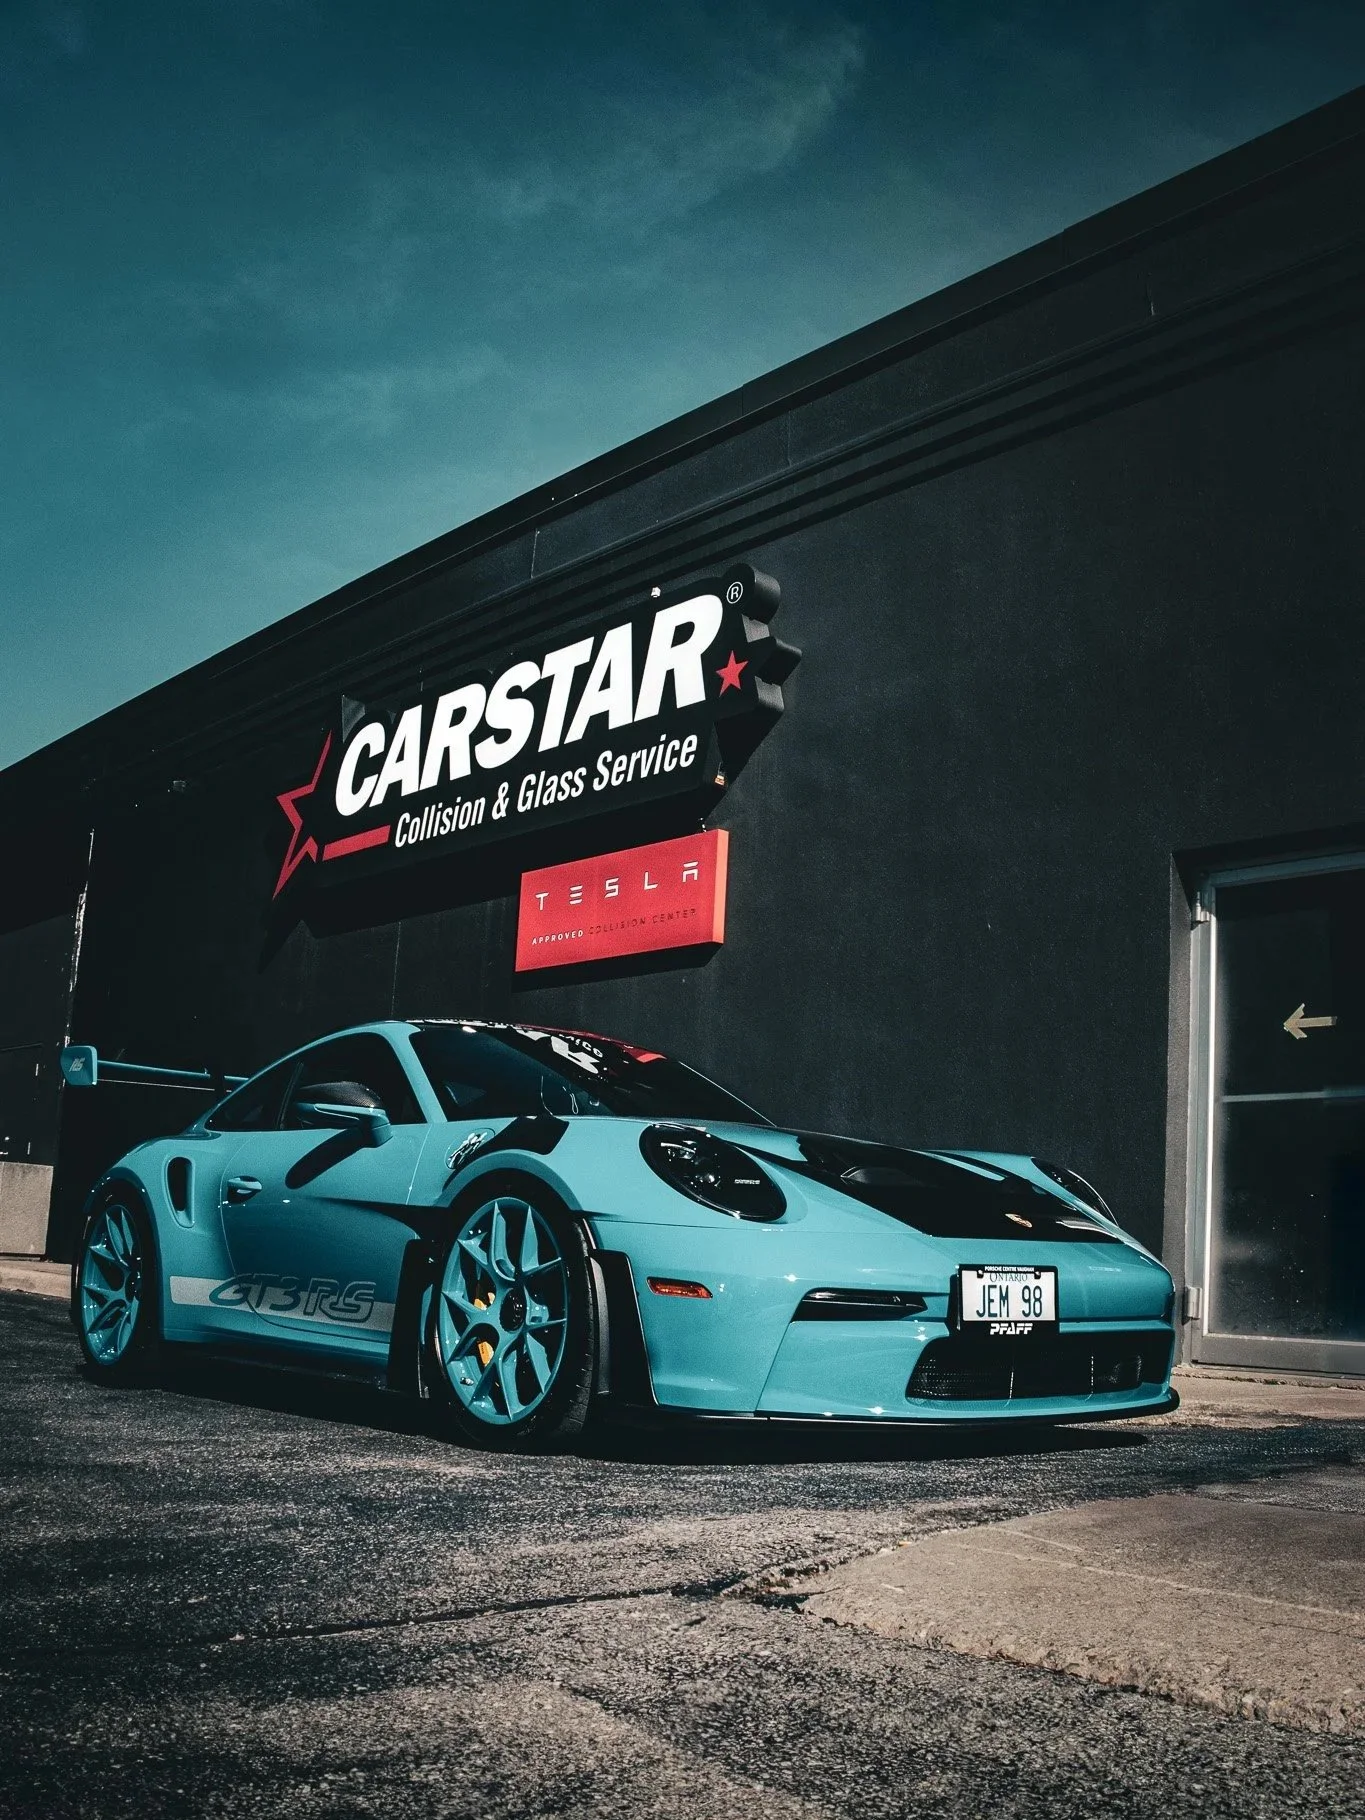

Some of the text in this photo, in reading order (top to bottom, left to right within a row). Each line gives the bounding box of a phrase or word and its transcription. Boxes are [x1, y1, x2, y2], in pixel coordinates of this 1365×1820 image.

[335, 594, 723, 817] CARSTAR
[395, 734, 698, 848] Collision & Glass Service
[535, 861, 698, 910] TESLA
[531, 908, 696, 945] APPROVED COLLISION CENTER
[976, 1284, 1042, 1318] JEM 98
[989, 1322, 1034, 1335] PFAFF
